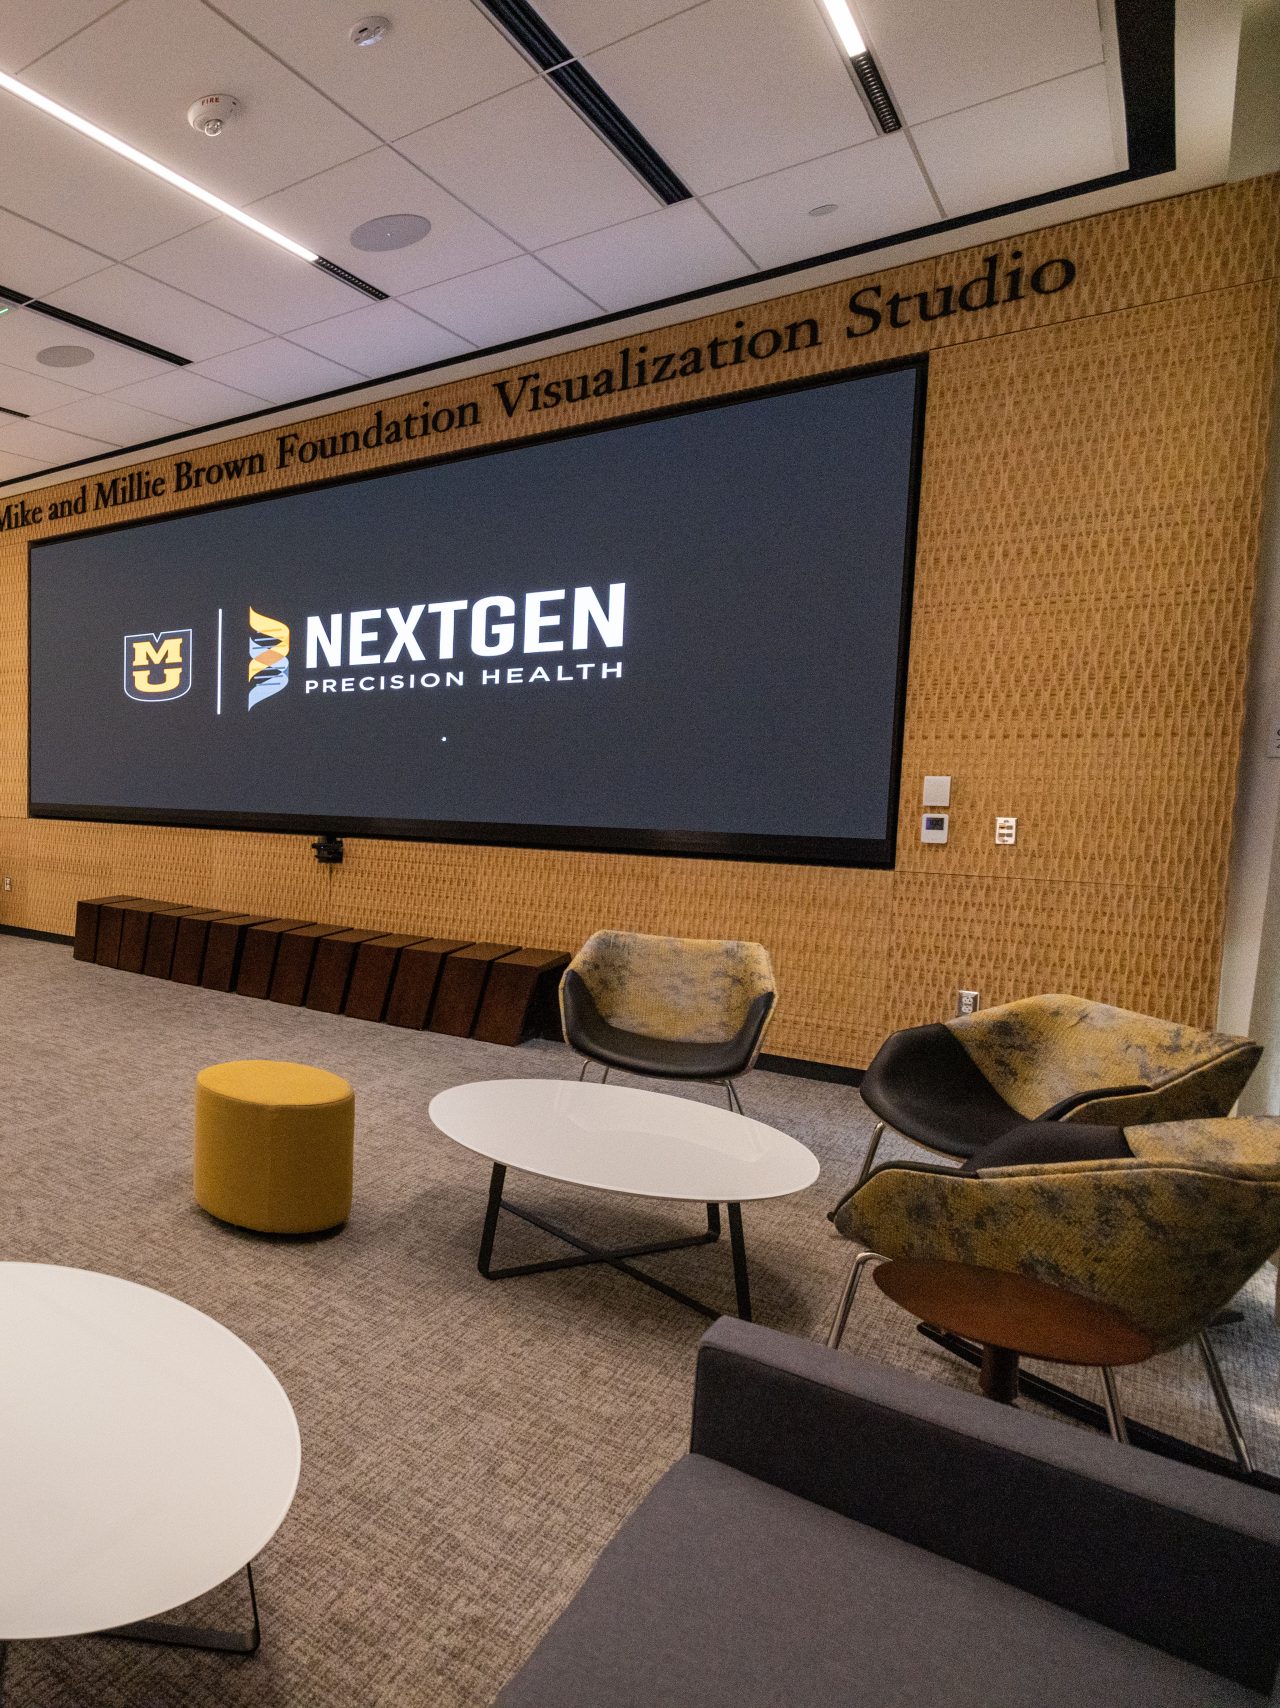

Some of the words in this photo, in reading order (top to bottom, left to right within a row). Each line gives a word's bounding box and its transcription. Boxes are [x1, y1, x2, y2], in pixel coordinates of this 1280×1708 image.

[201, 97, 220, 106] FIRE
[48, 485, 86, 521] and
[94, 470, 166, 510] Millie
[173, 450, 266, 493] Brown
[276, 401, 481, 470] Foundation
[493, 317, 822, 418] Visualization
[846, 251, 1077, 338] Studio
[305, 583, 627, 669] NEXTGEN
[305, 672, 465, 694] PRECISION
[482, 661, 624, 685] HEALTH
